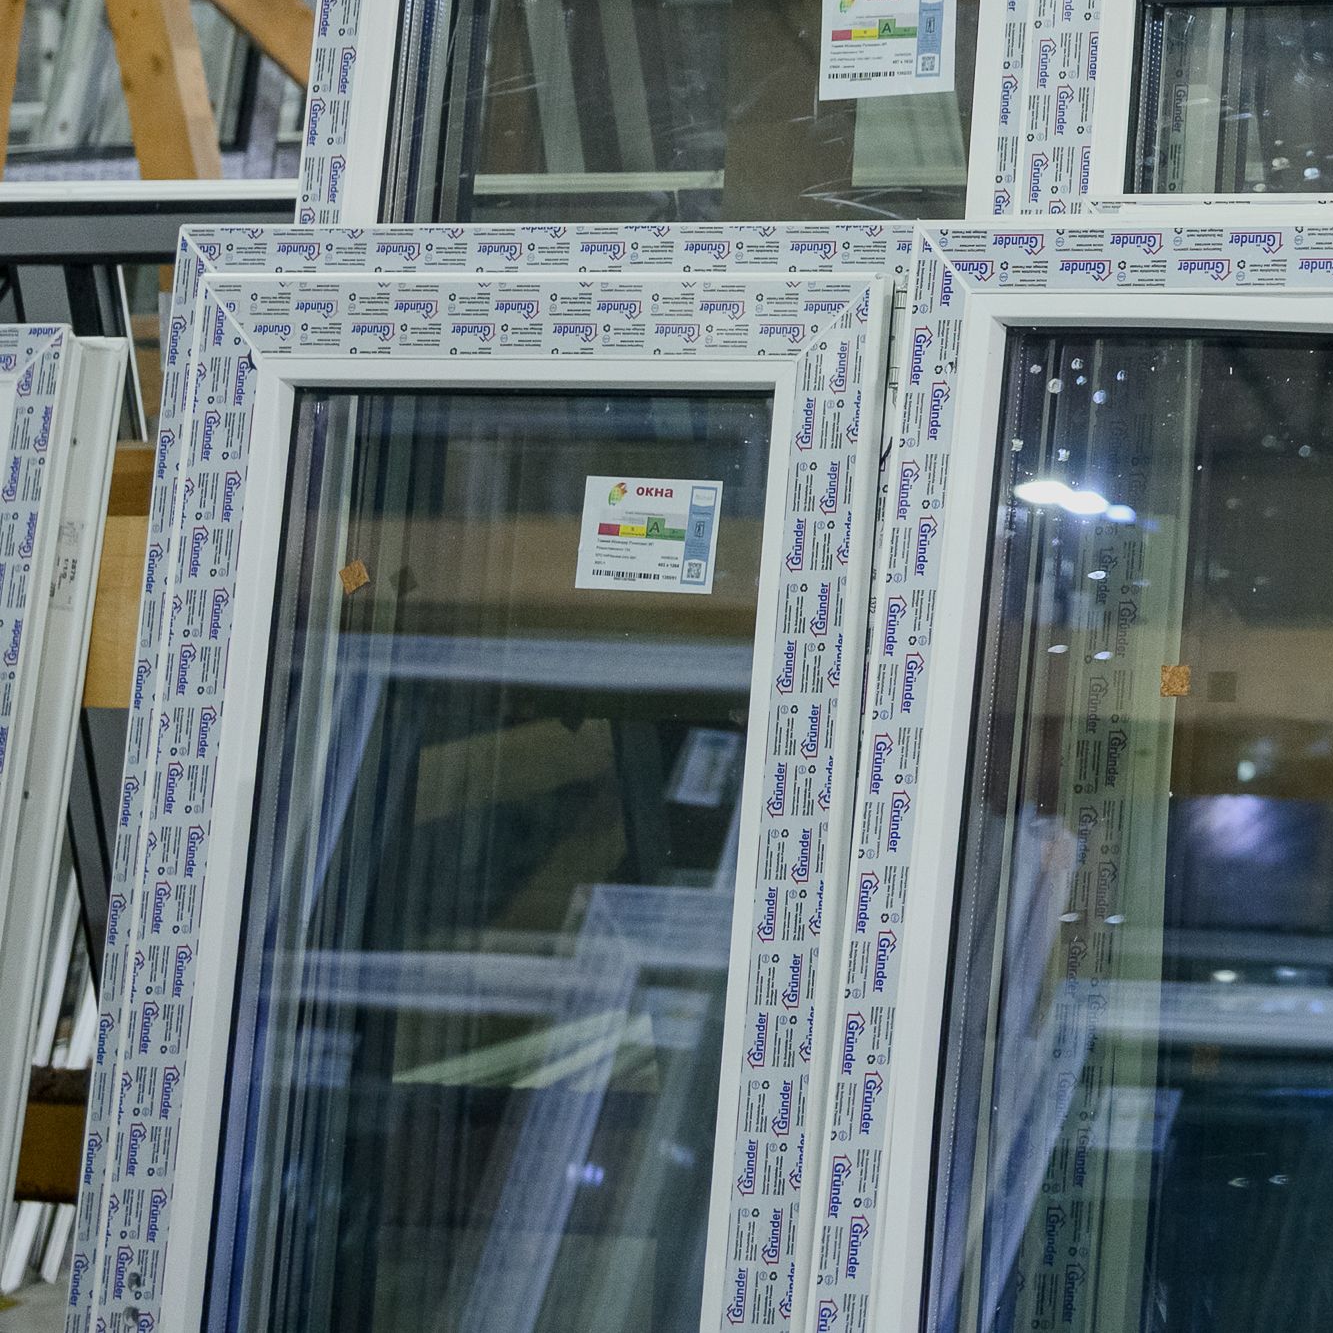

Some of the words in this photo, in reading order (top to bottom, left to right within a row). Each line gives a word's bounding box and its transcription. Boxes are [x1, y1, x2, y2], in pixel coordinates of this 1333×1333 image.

[911, 333, 927, 386] Gründer
[927, 387, 946, 440] Gründer
[635, 486, 674, 499] окна
[897, 468, 914, 519] Gründer
[175, 643, 194, 696] Gründer
[901, 659, 919, 713] Gründer
[855, 878, 874, 934] Gründer
[159, 1065, 178, 1120] Gründer
[741, 1139, 759, 1190] Gründer
[845, 1221, 865, 1279] Gründer
